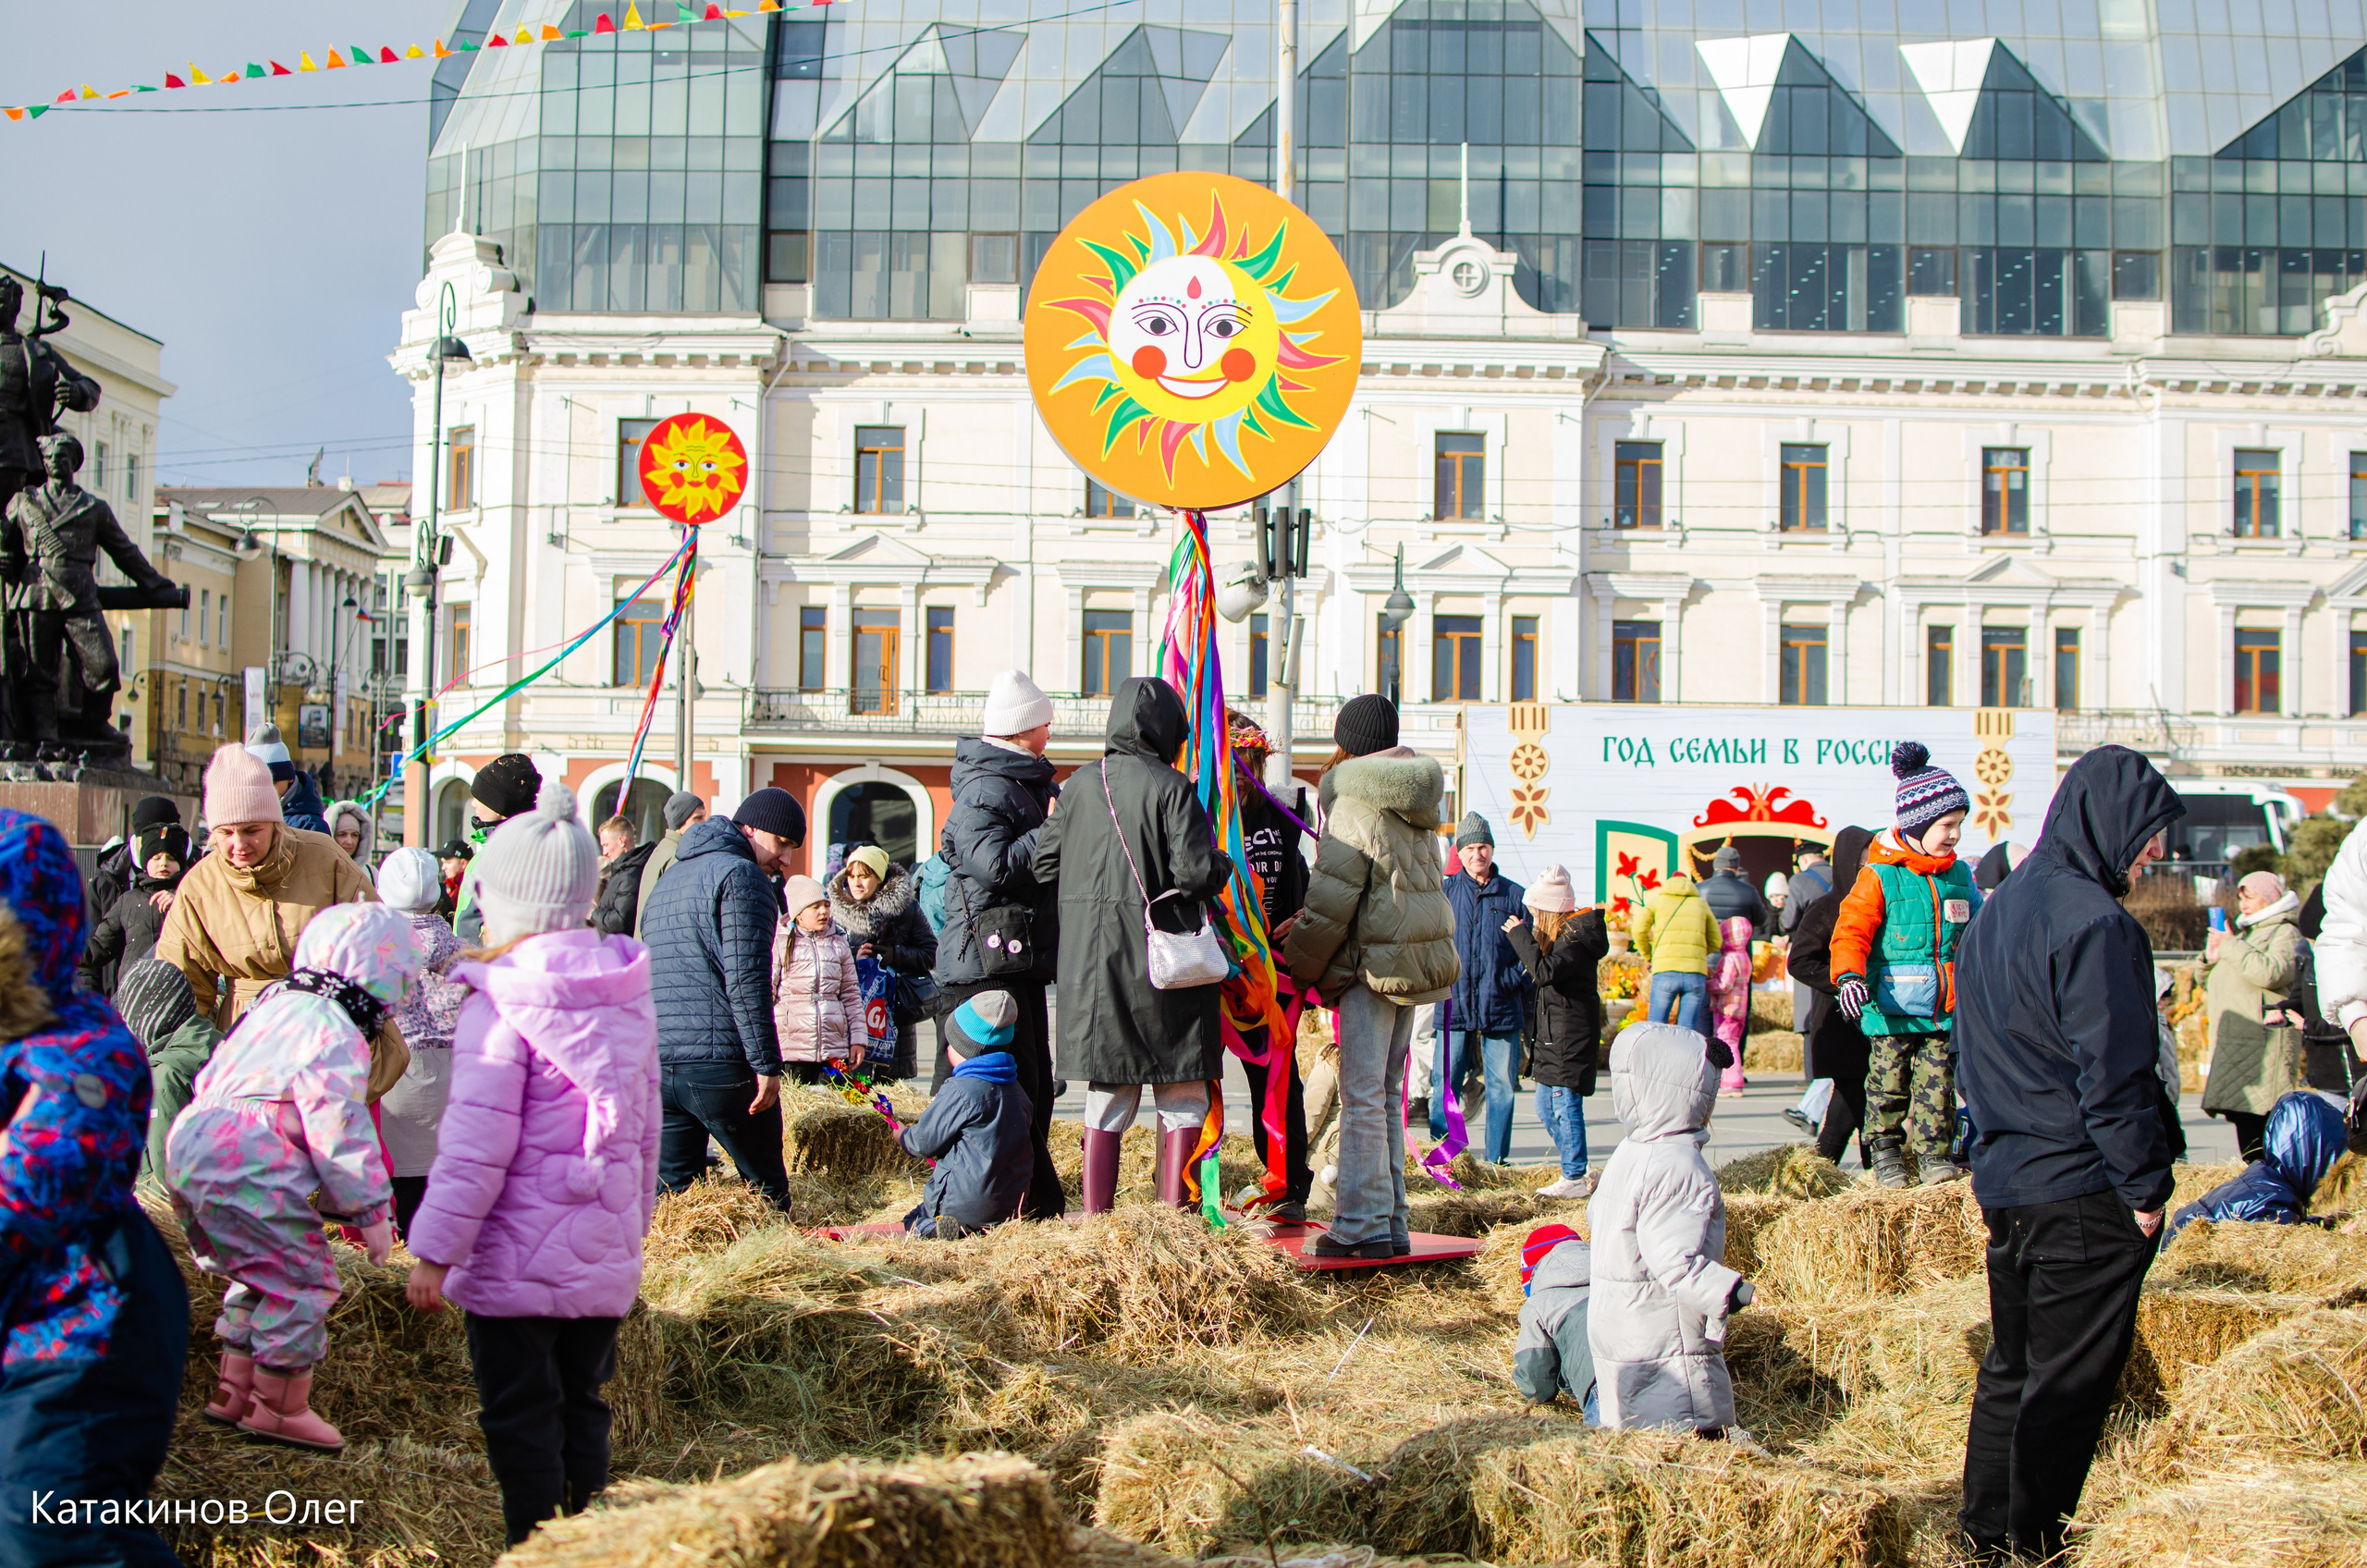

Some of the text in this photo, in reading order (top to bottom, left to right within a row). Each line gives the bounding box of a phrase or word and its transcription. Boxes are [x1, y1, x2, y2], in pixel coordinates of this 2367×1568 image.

[1603, 737, 1655, 768] ГОД
[1670, 738, 1766, 765] СЕМЬИ
[1784, 739, 1800, 765] В
